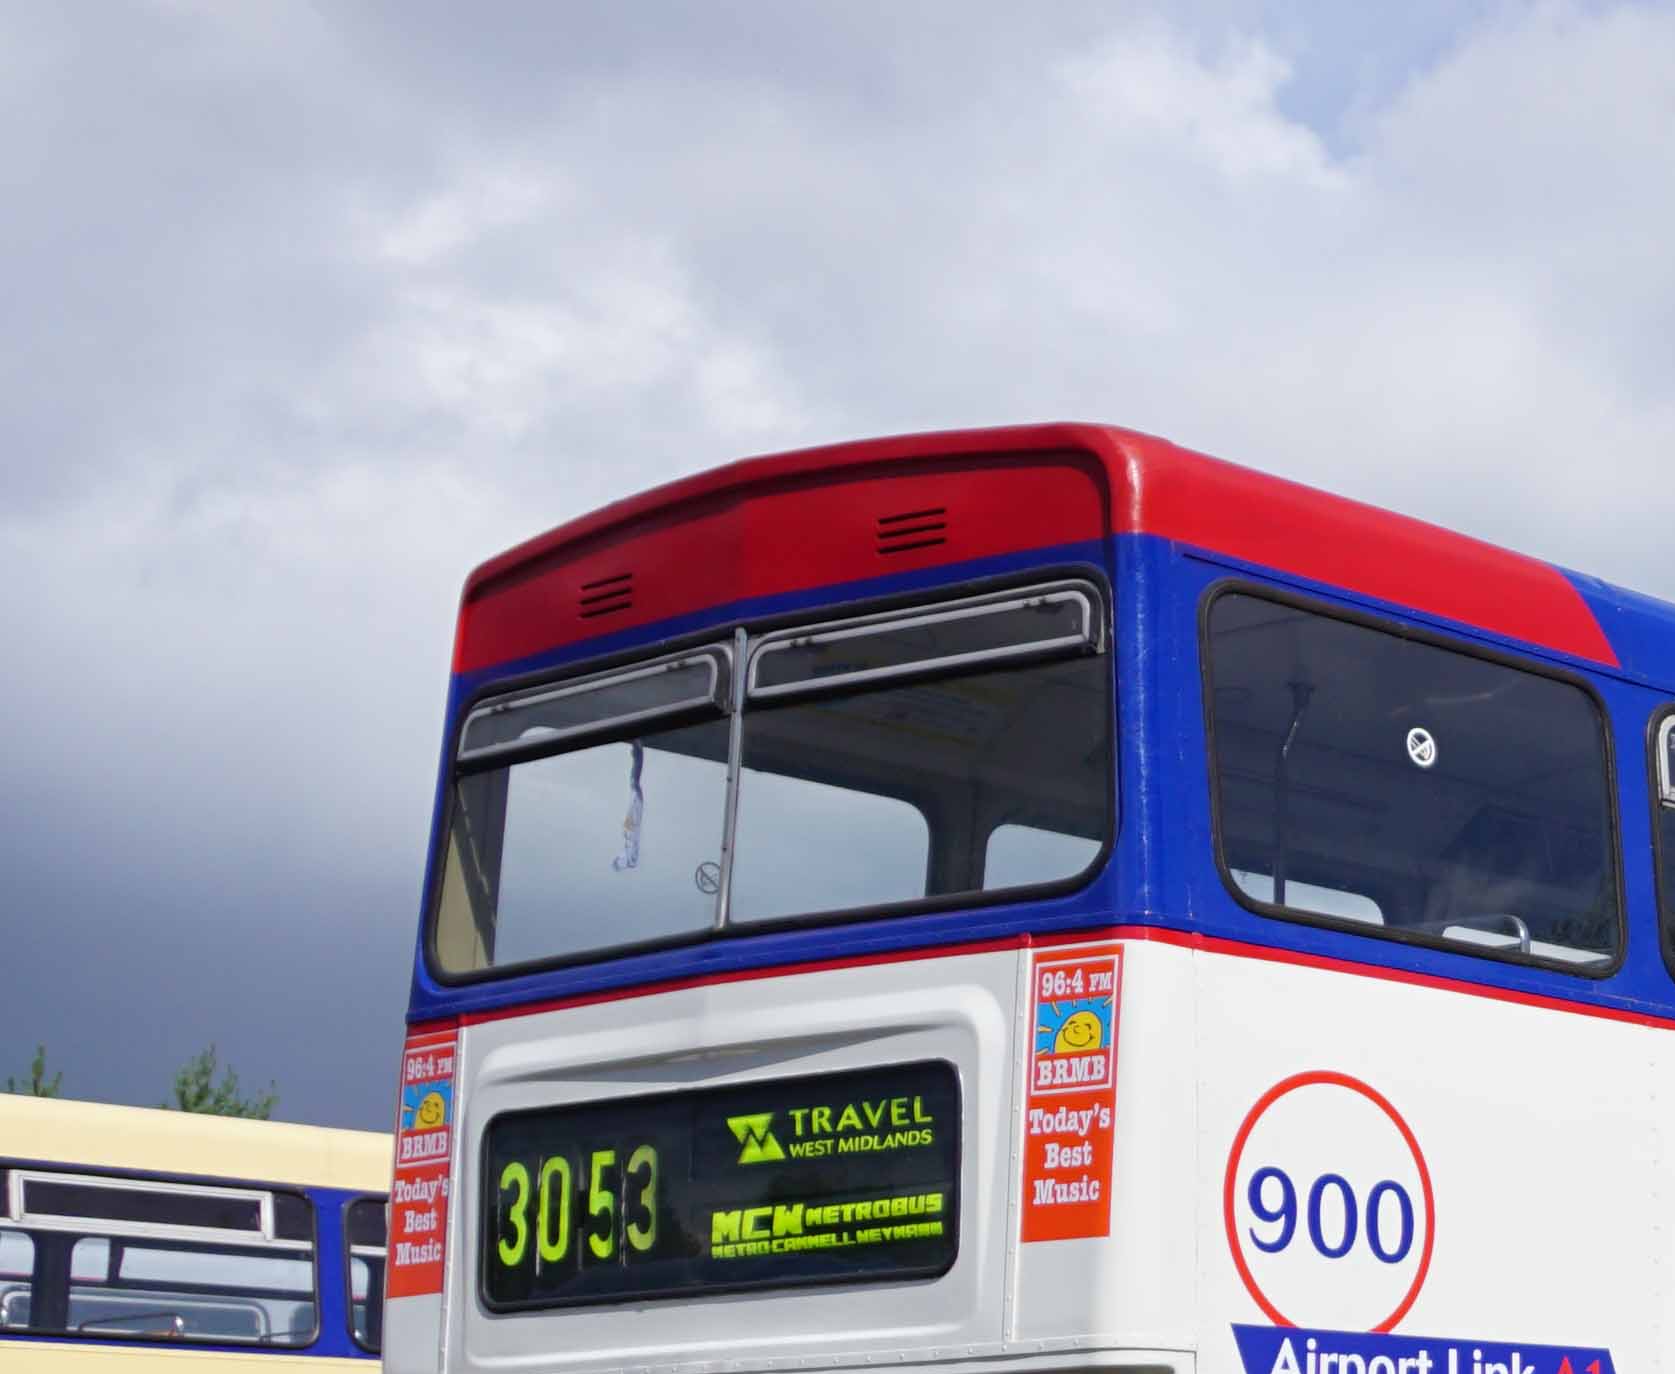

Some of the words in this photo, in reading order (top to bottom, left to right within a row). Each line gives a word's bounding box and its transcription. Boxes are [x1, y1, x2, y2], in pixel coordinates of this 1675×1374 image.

[1041, 968, 1084, 997] 96:4
[1089, 971, 1112, 992] FM
[1037, 1055, 1105, 1086] BRMB
[789, 1095, 934, 1137] TRAVEL
[1029, 1103, 1111, 1137] Today's
[401, 1131, 447, 1159] BRMB
[789, 1140, 834, 1158] WEST
[838, 1128, 933, 1154] MIDLANDS
[1044, 1141, 1092, 1169] Best
[395, 1174, 449, 1204] Today's
[1033, 1175, 1100, 1205] Music
[404, 1208, 437, 1233] Best
[499, 1144, 657, 1267] 3053
[711, 1203, 803, 1243] MCW
[805, 1192, 944, 1227] METROBUS
[1246, 1165, 1415, 1264] 900
[395, 1238, 441, 1266] Music
